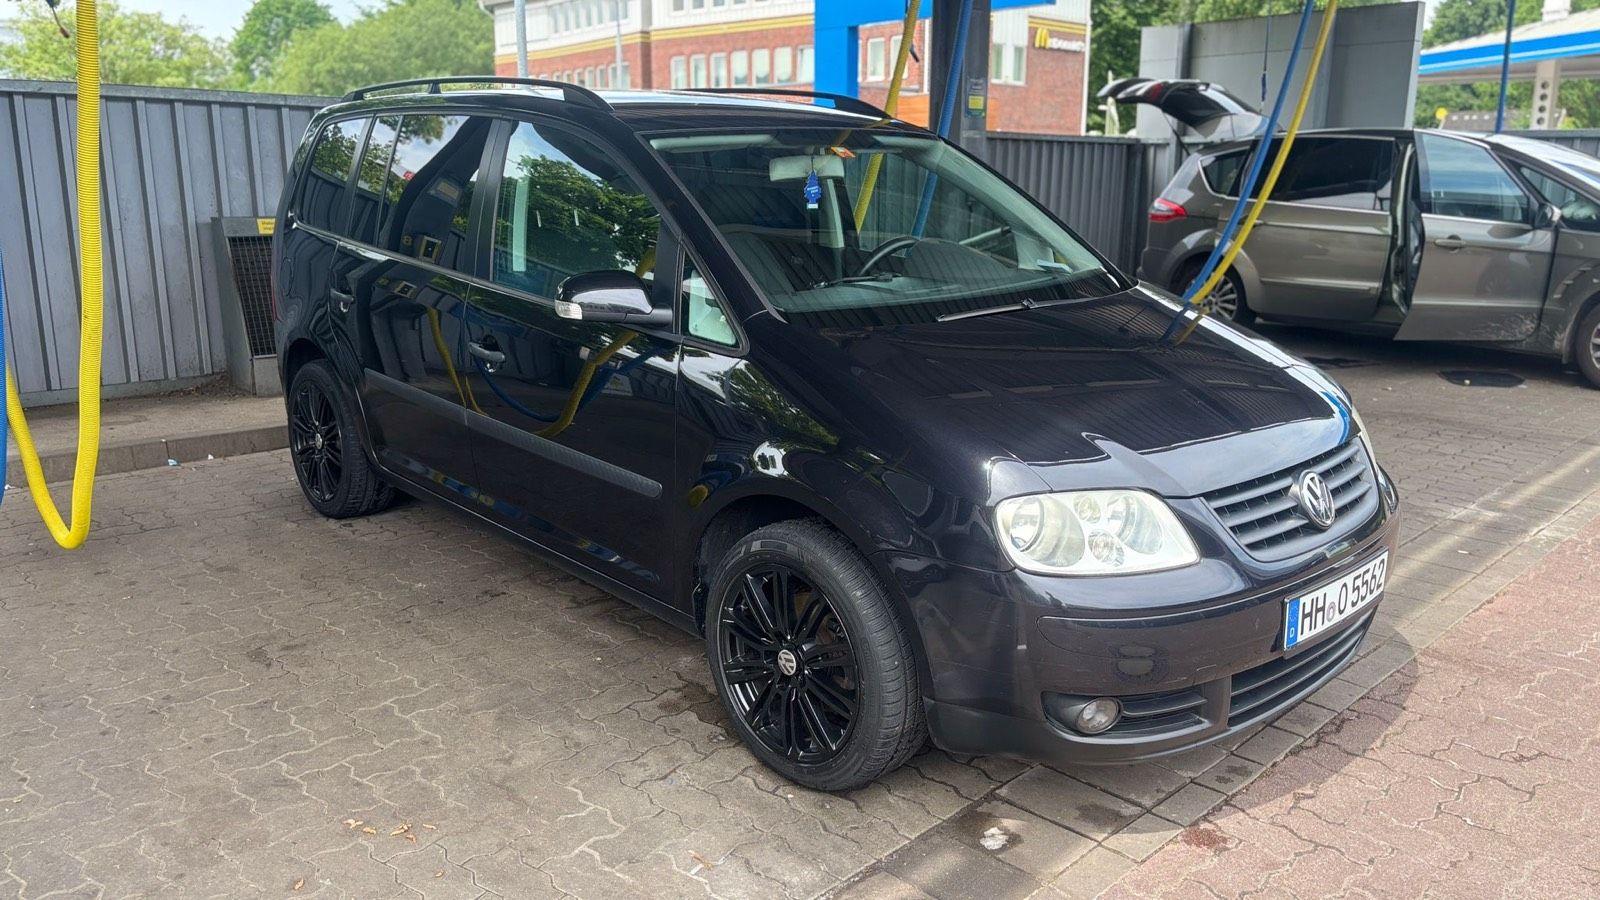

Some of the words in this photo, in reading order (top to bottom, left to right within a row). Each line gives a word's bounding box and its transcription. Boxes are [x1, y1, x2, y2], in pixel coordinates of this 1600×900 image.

[1300, 592, 1327, 636] HH
[1351, 558, 1385, 608] 5562
[1290, 627, 1295, 638] D
